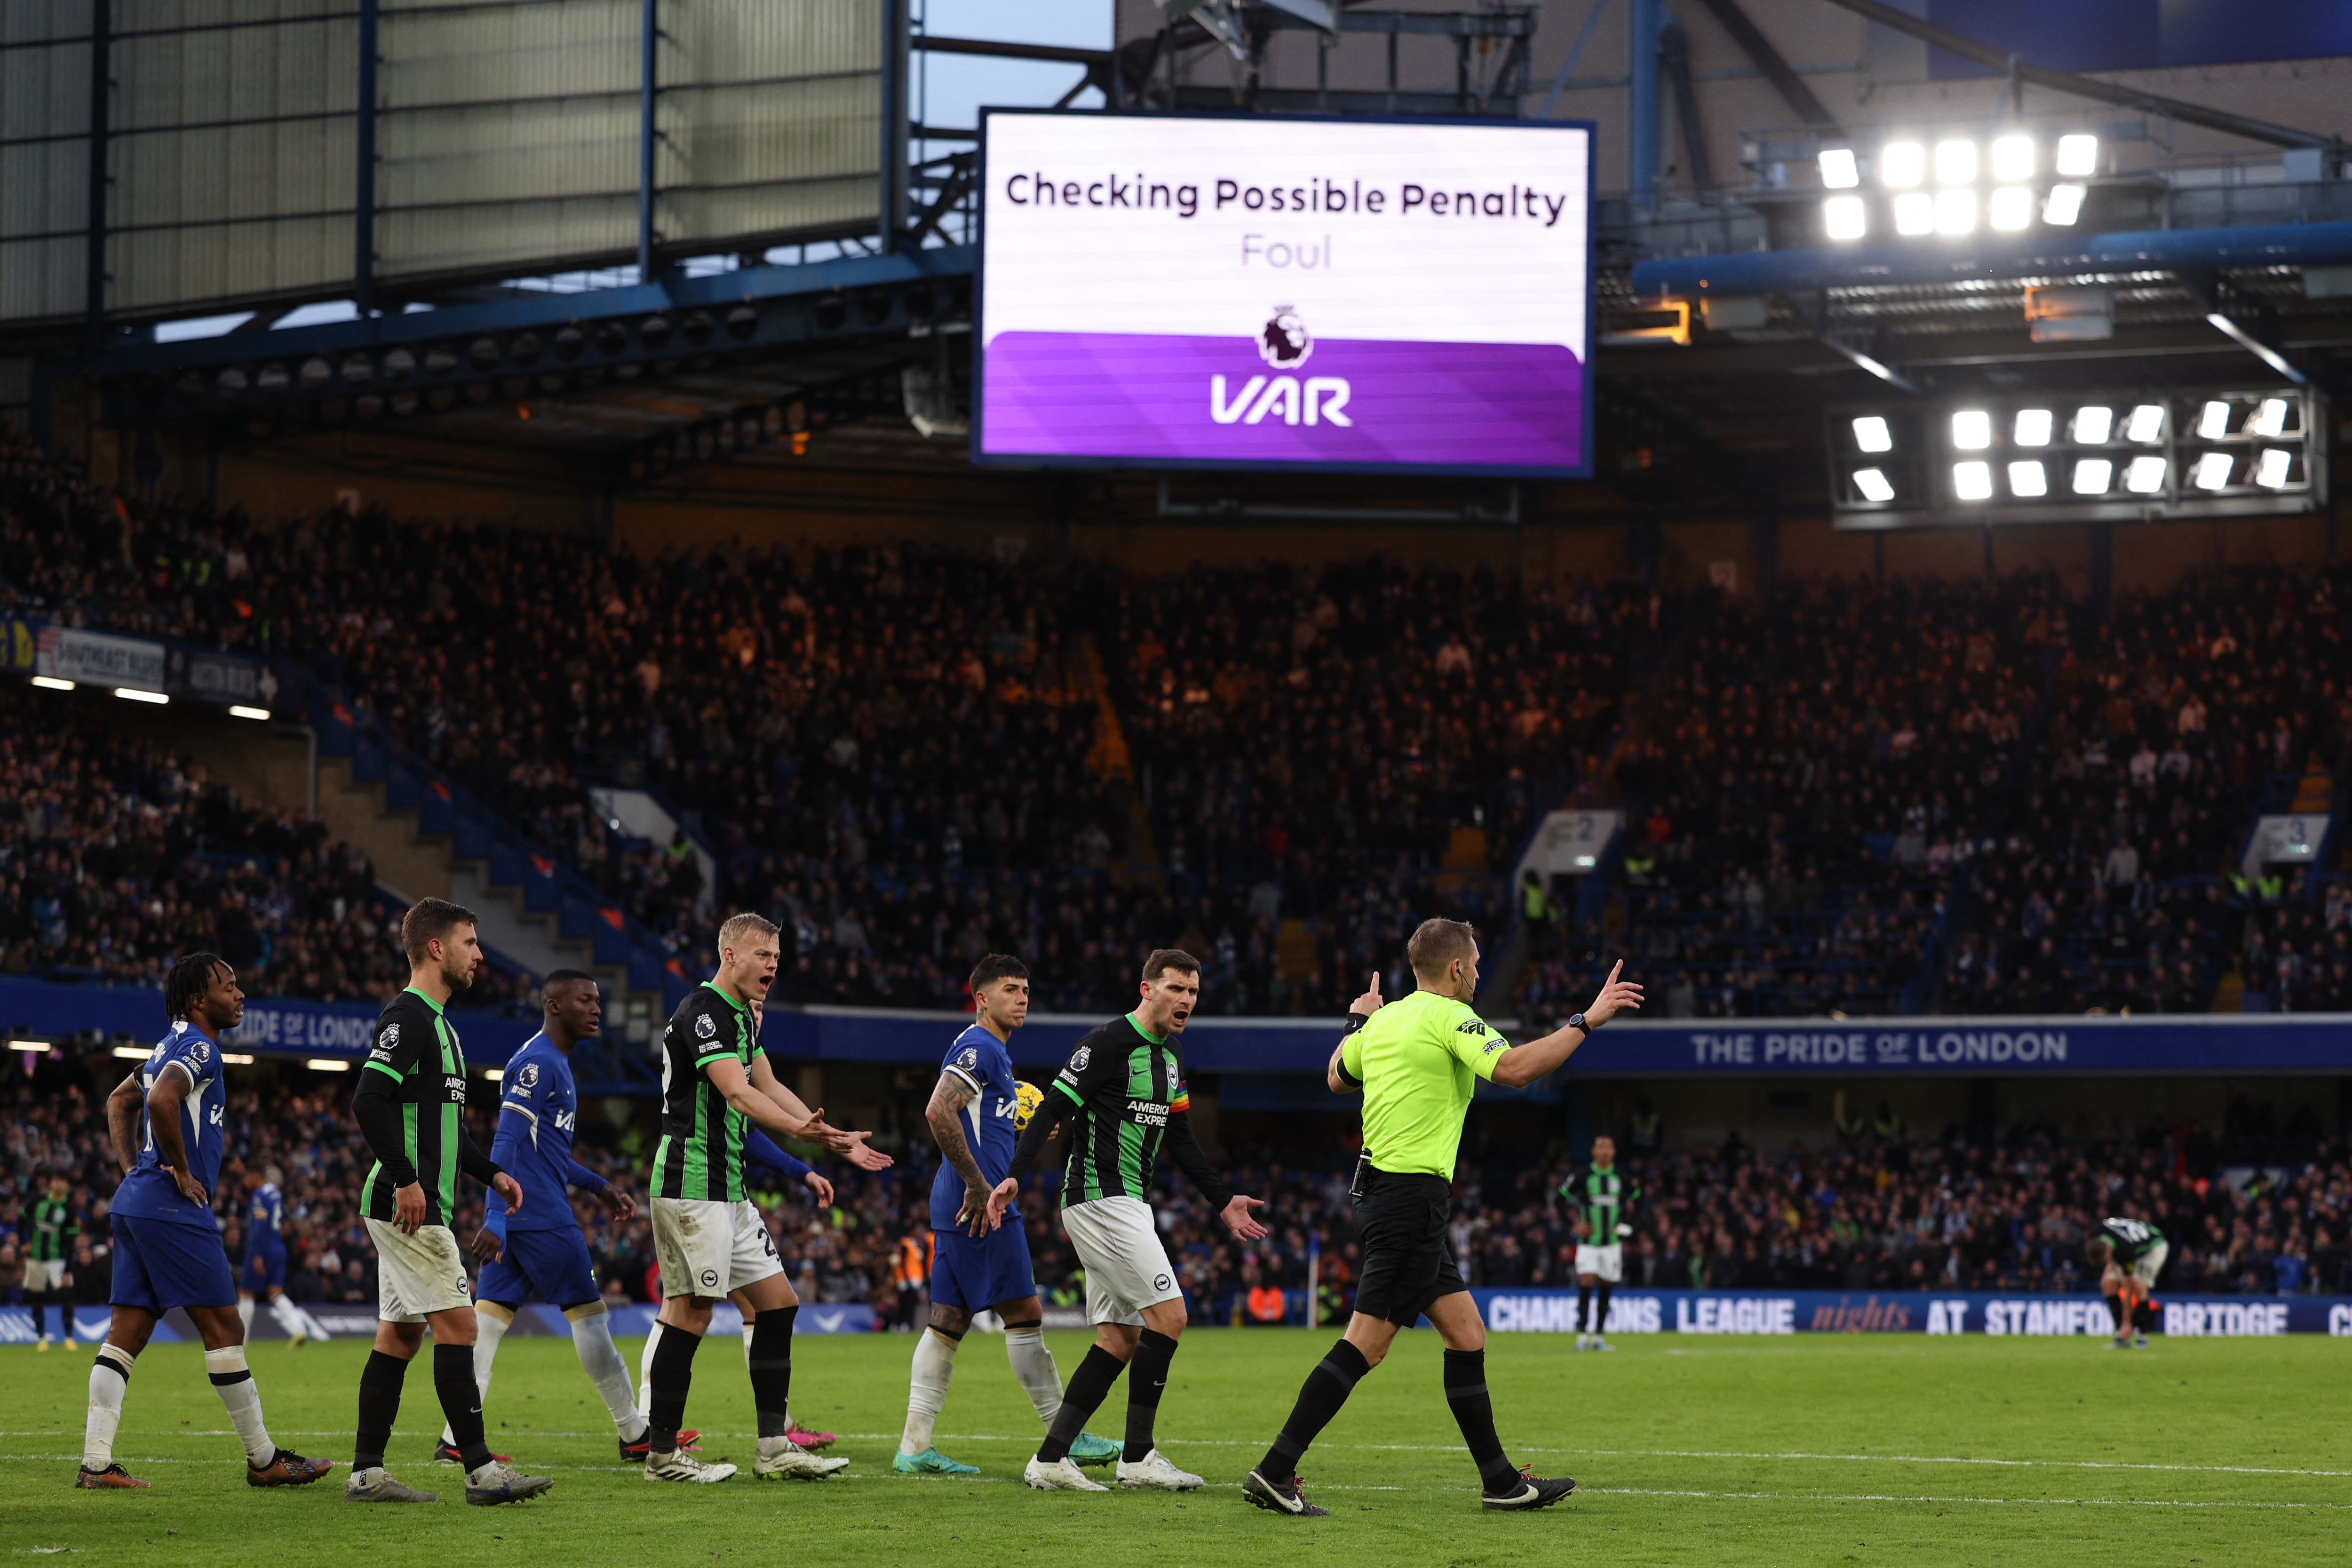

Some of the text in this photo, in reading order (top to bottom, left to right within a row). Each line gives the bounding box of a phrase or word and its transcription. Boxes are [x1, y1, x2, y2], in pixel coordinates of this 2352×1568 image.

[1008, 171, 1565, 227] Checking Possible Penalty
[1242, 233, 1330, 269] Foul
[1210, 374, 1353, 427] VAR
[1692, 1033, 2067, 1063] THE PRIDE OF LONDON
[190, 1059, 201, 1071] room
[1066, 1072, 1078, 1082] room
[518, 1087, 532, 1095] room
[757, 1227, 776, 1257] 2
[1676, 1298, 1795, 1335] LEAGUE
[1812, 1295, 1910, 1332] nights
[1926, 1300, 1969, 1336] AT
[2164, 1302, 2288, 1337] BRIDGE
